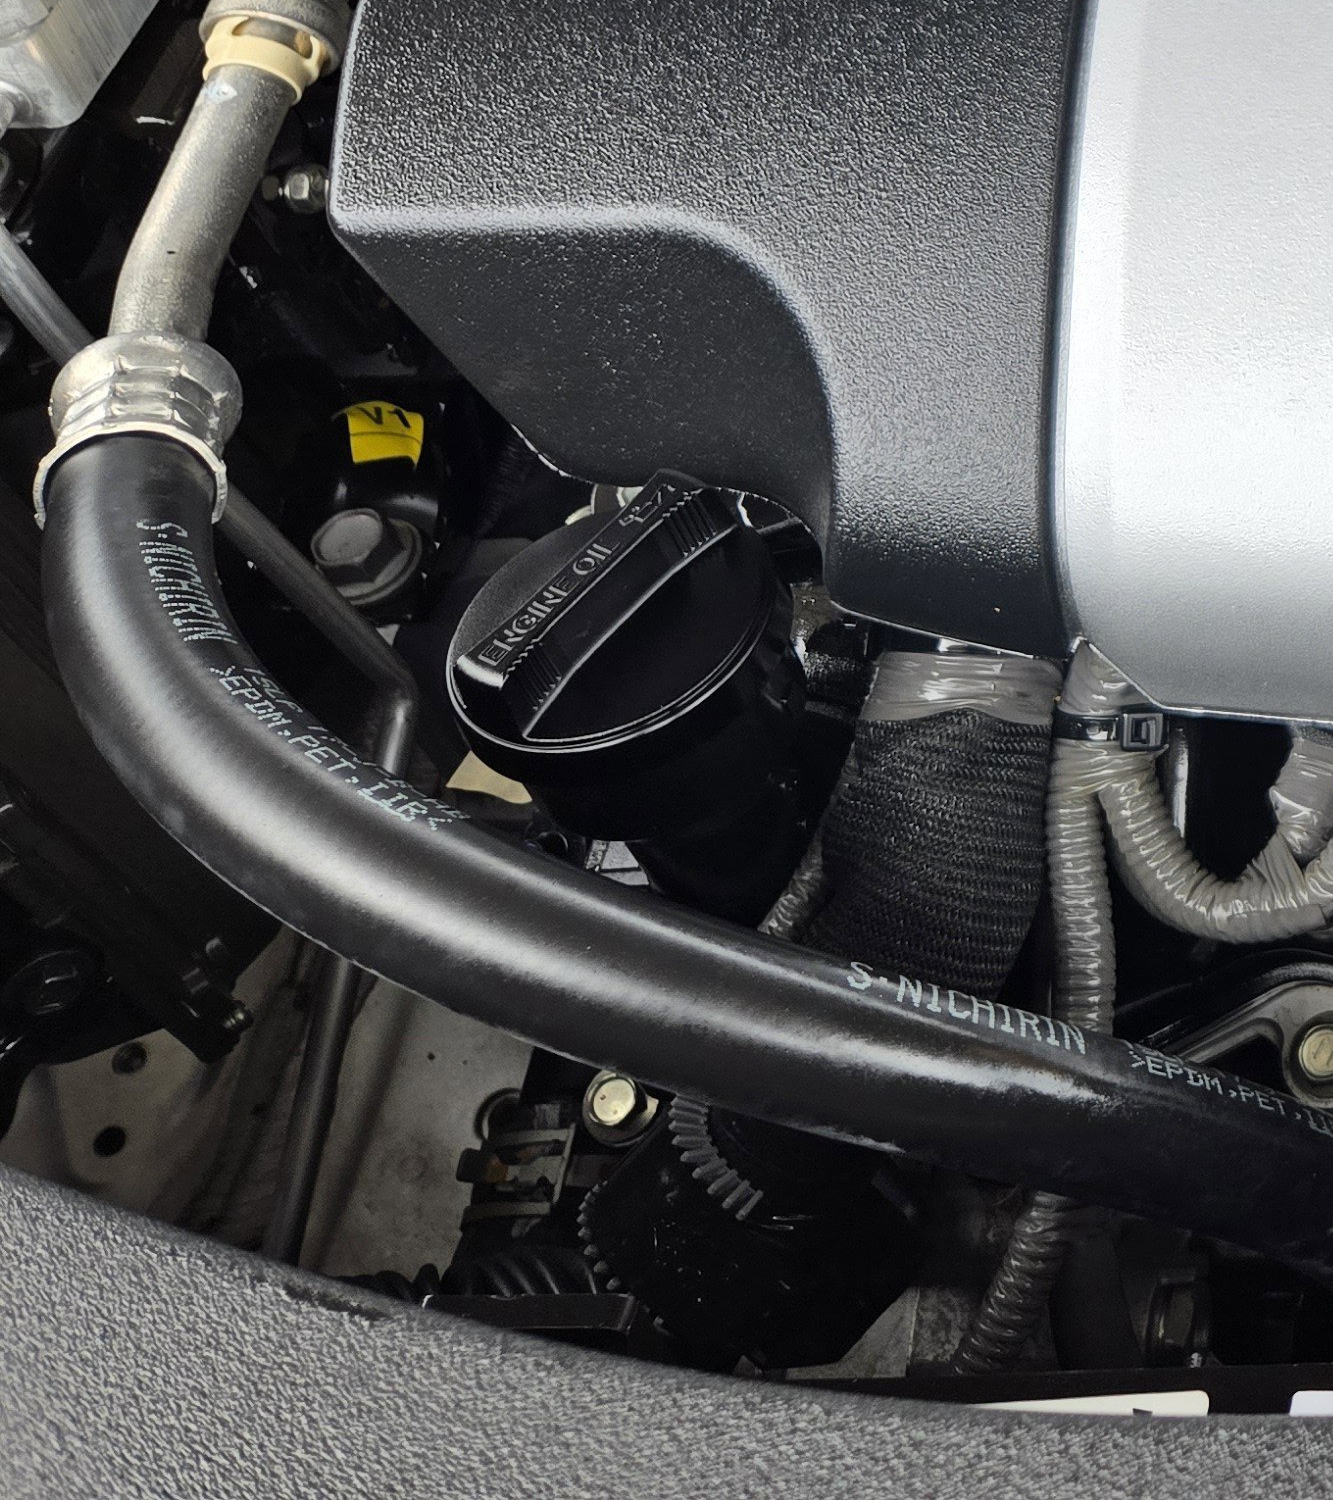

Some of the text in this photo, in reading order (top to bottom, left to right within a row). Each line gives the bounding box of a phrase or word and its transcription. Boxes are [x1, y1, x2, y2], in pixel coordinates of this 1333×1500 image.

[356, 406, 411, 429] V1
[477, 542, 621, 667] ENGINE OIL
